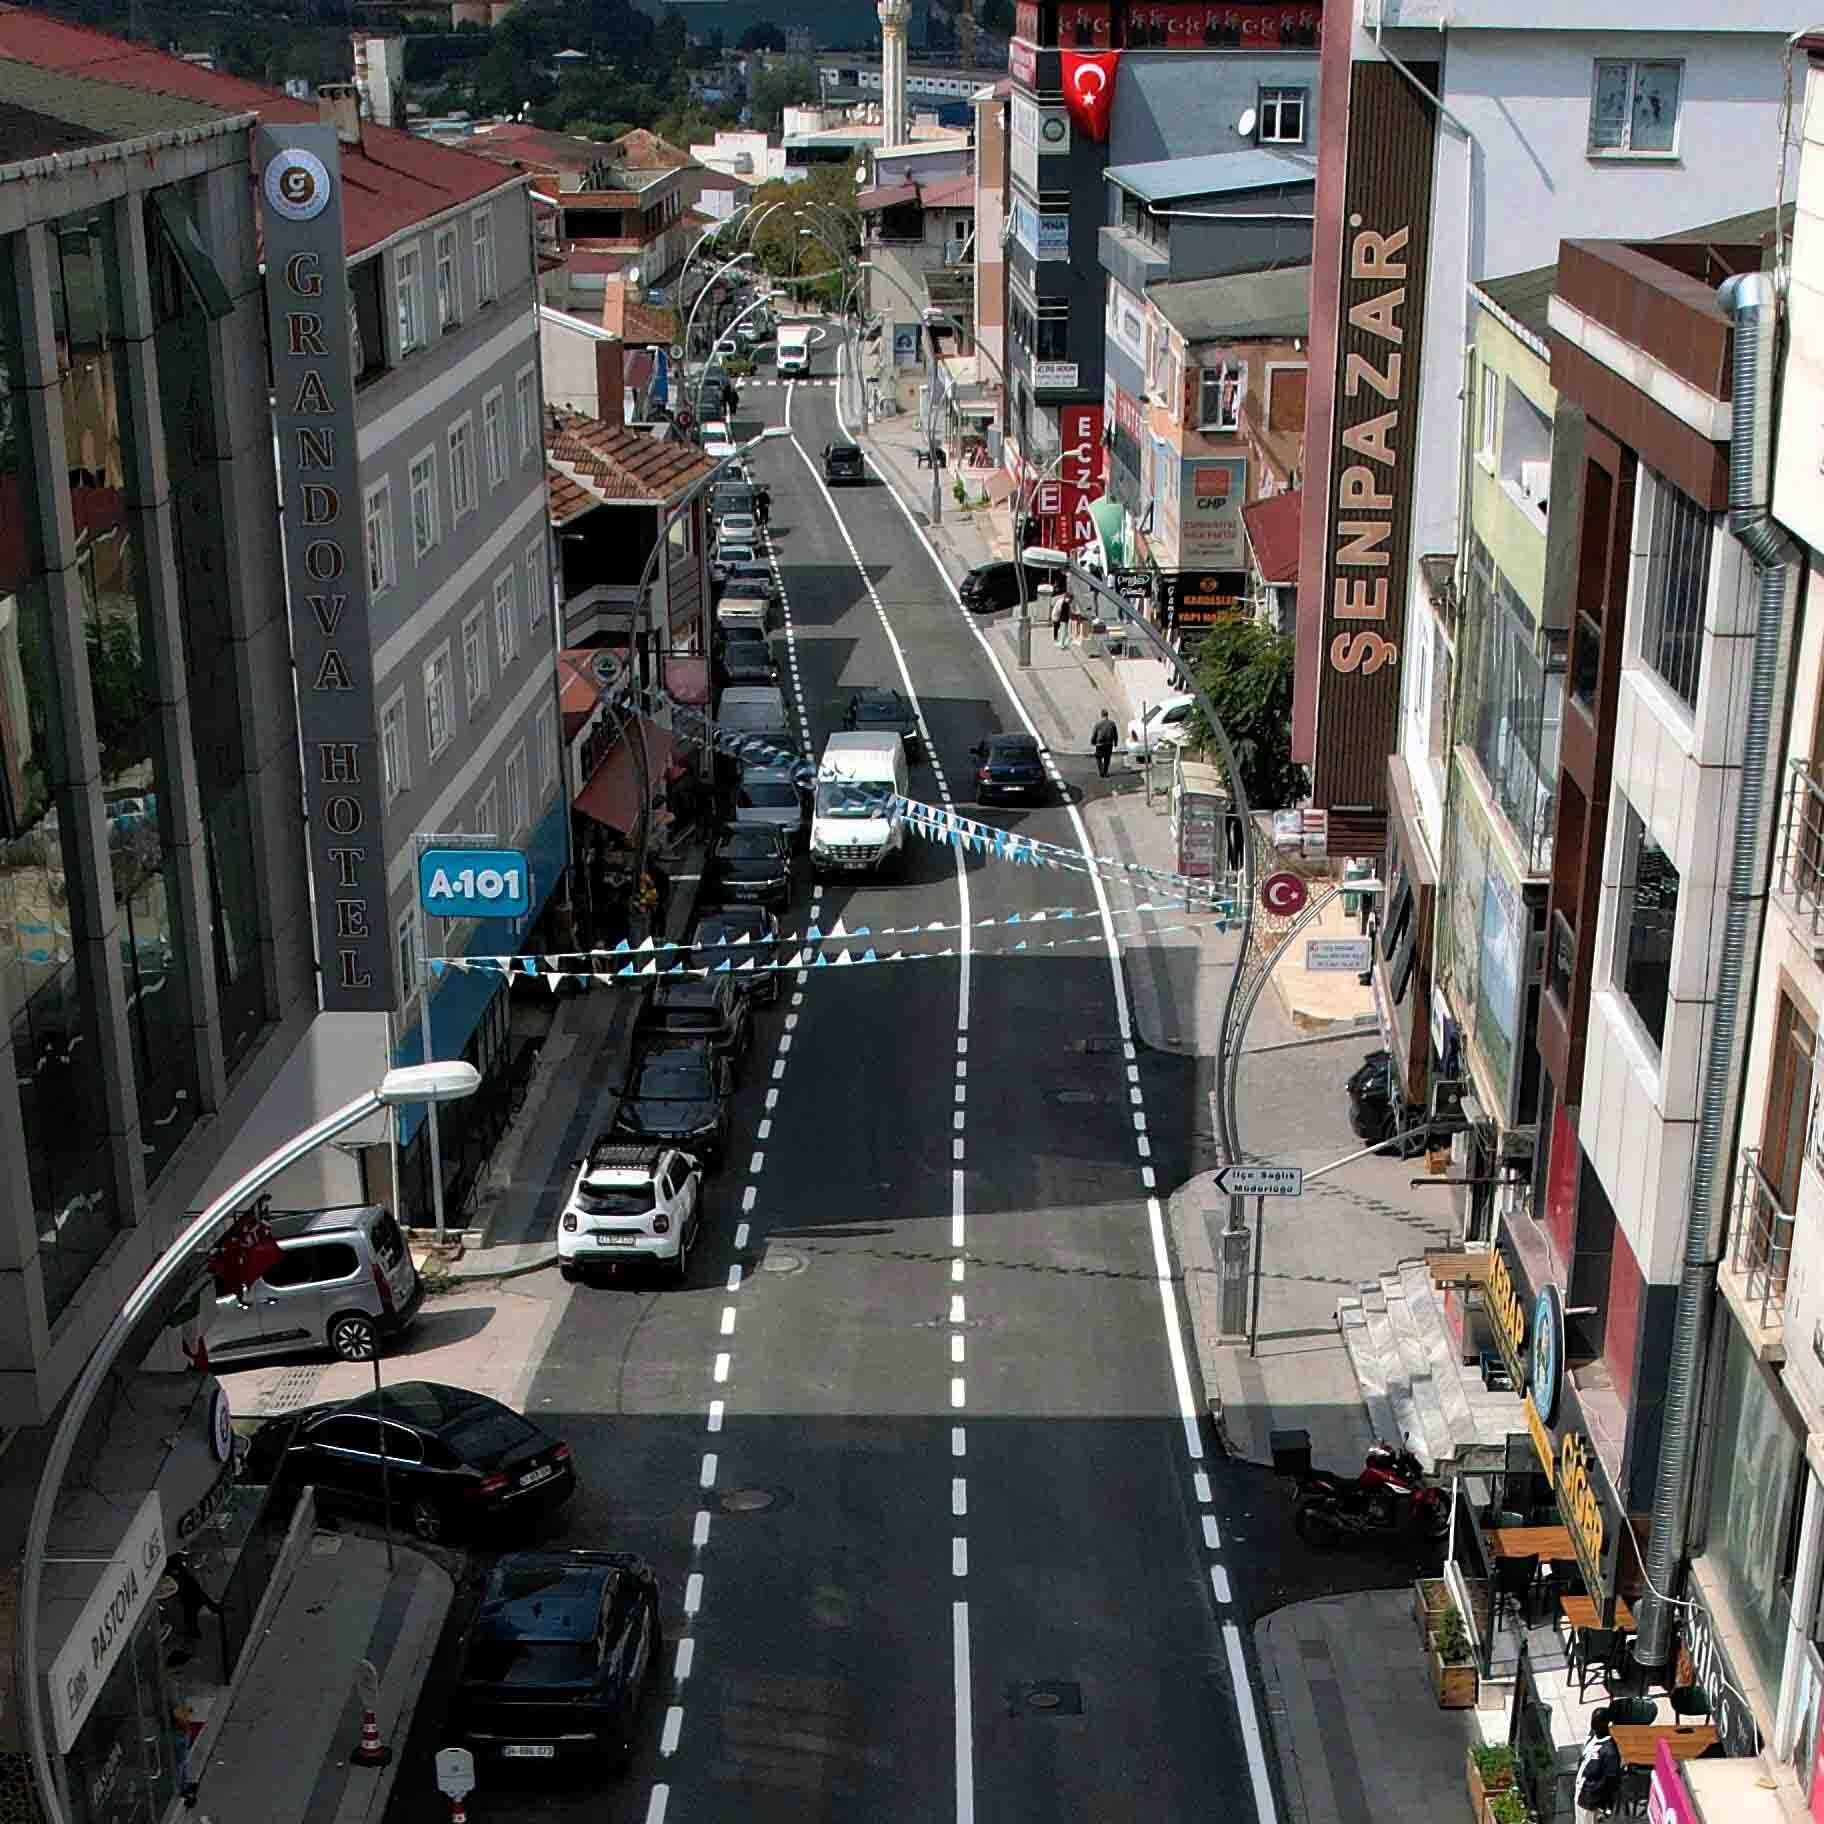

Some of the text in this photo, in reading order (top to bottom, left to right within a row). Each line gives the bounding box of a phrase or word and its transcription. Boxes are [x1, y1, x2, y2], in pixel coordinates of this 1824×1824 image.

[285, 251, 354, 691] GRANDOVA
[1075, 416, 1092, 541] ECZAN
[1330, 225, 1410, 676] ŞENPAZAR
[319, 743, 372, 989] HOTEL
[1488, 1248, 1524, 1351] KEBAP
